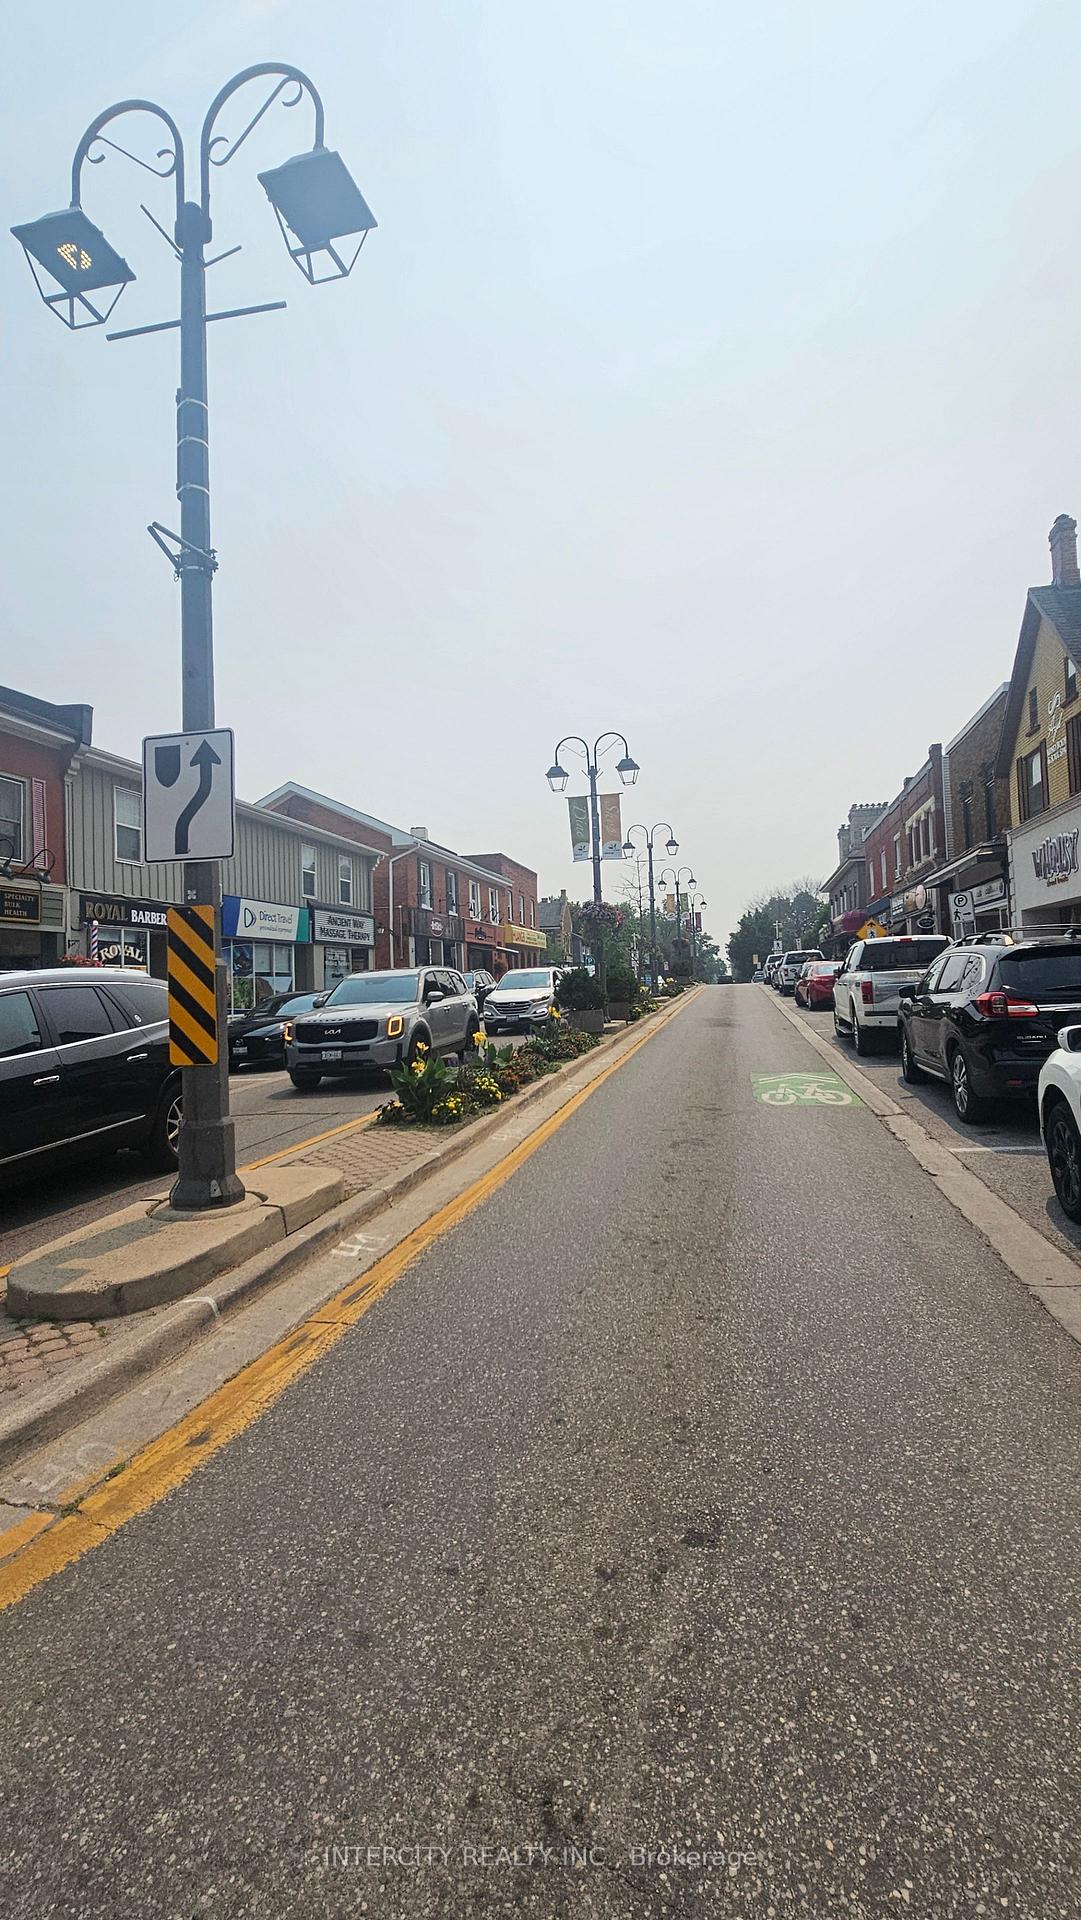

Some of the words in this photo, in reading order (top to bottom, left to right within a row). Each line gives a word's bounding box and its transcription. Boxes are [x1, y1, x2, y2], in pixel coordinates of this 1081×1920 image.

[4, 909, 28, 917] HEALTH
[85, 901, 128, 920] ROYAL
[259, 910, 277, 923] Direct
[277, 913, 292, 924] Travel
[327, 916, 351, 928] ANCIENT
[352, 918, 366, 929] WAY
[319, 927, 346, 939] MASSAGE
[347, 929, 370, 941] THERAPY
[99, 944, 144, 962] ROYAL
